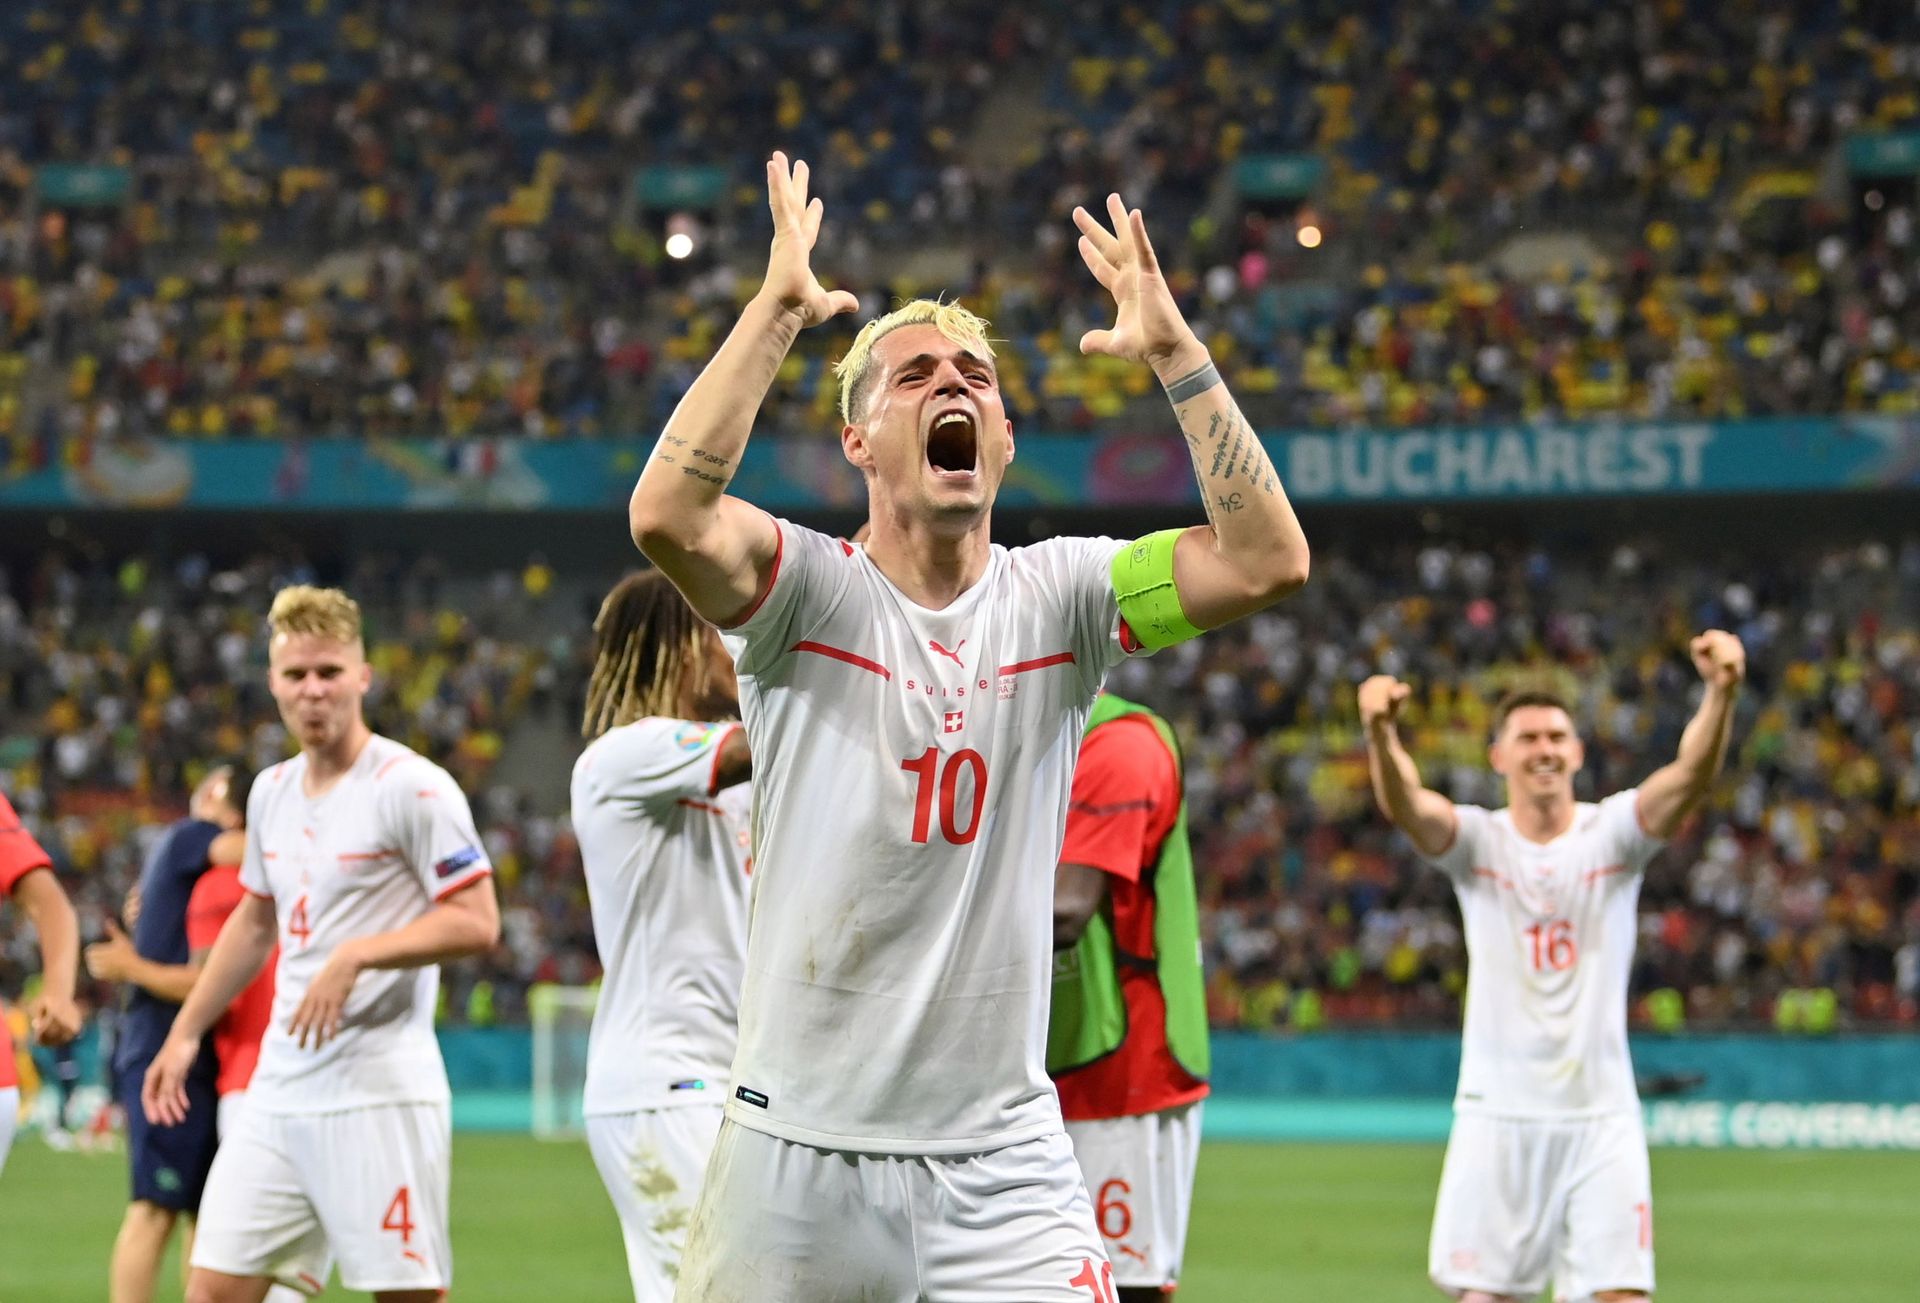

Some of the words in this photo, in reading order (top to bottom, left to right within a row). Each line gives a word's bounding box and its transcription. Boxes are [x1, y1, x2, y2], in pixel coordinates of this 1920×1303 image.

[1288, 425, 1709, 498] BUCHAREST
[1217, 492, 1244, 514] 34
[901, 746, 988, 846] 10
[288, 896, 312, 947] 4
[1523, 920, 1578, 972] 16
[382, 1186, 416, 1243] 4
[1097, 1178, 1131, 1239] 6
